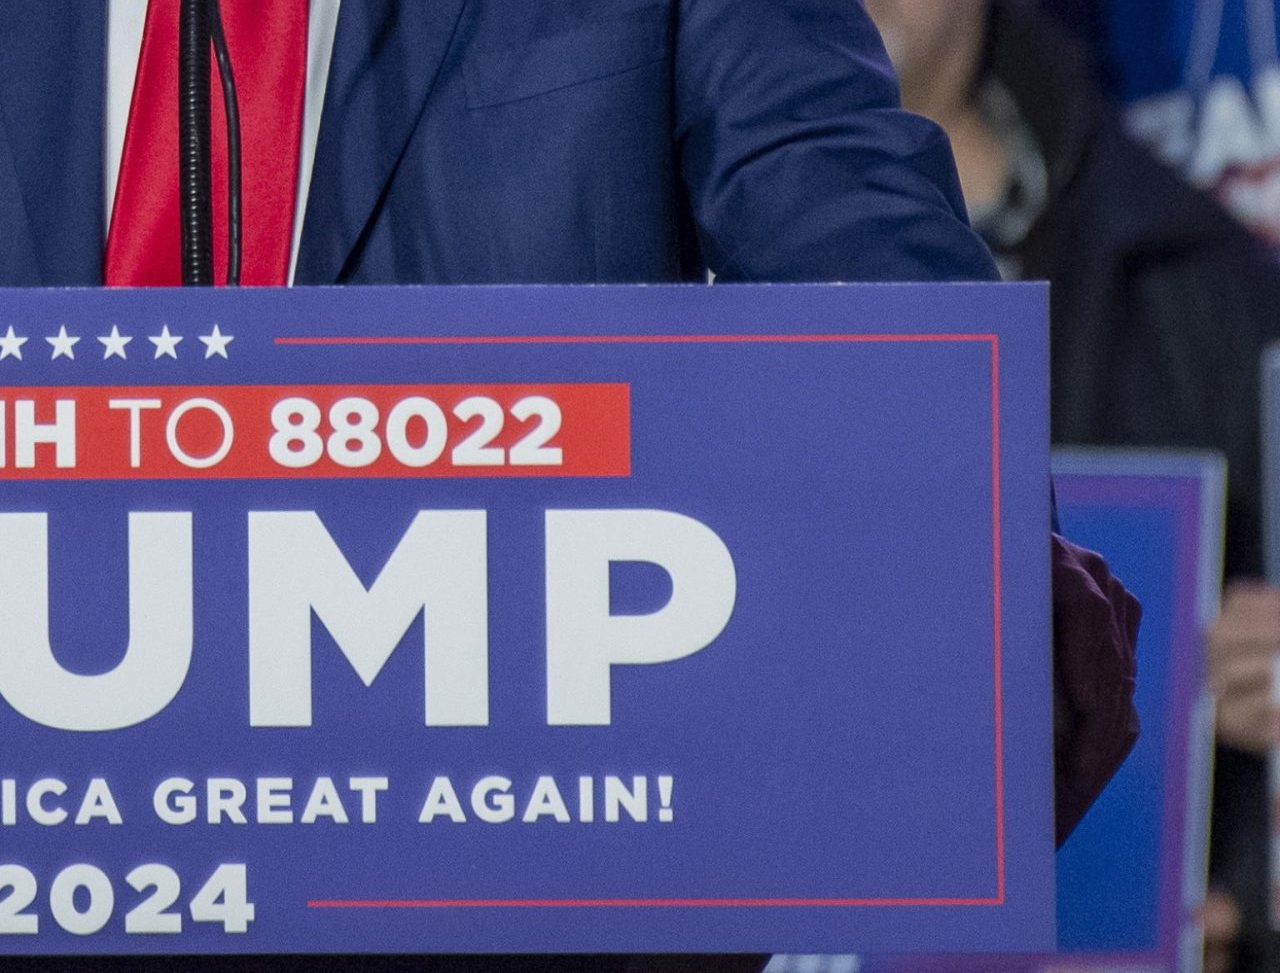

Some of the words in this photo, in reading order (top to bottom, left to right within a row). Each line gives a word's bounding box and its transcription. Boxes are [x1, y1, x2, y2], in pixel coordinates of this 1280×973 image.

[106, 396, 236, 470] TO
[266, 393, 565, 470] 88022
[150, 773, 391, 826] GREAT
[416, 771, 675, 825] AGAIN!
